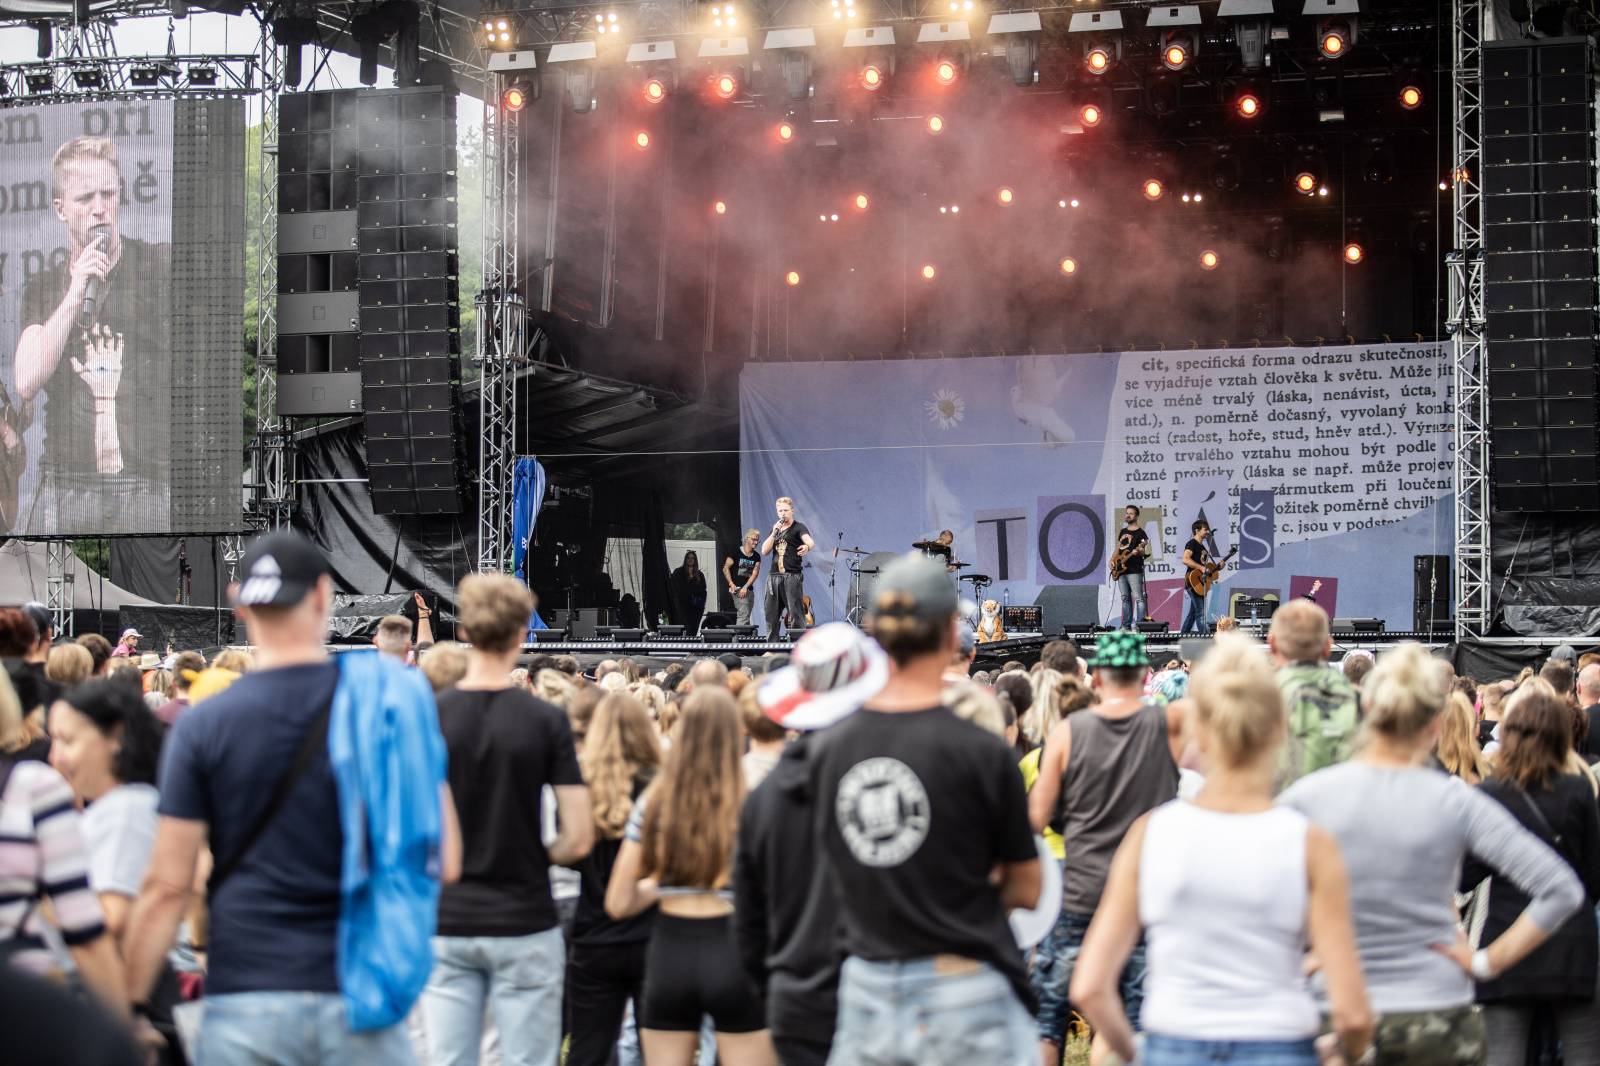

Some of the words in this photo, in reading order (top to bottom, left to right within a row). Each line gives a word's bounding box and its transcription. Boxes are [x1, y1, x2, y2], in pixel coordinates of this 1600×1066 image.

[1142, 357, 1169, 372] cit,
[1175, 355, 1246, 373] specifická
[1252, 353, 1295, 367] forma
[1302, 352, 1352, 365] odrazu
[1359, 345, 1447, 362] skutečnosti,
[1125, 380, 1139, 390] se
[1145, 376, 1212, 392] vyjadřuje
[1218, 373, 1257, 387] vztah
[1263, 371, 1318, 385] člověka
[1324, 370, 1333, 383] k
[1339, 368, 1382, 382] světu.
[1389, 364, 1432, 379] Může
[1125, 396, 1153, 409] více
[1163, 394, 1203, 407] méně
[1213, 391, 1255, 406] trvalý
[1266, 389, 1313, 406] (láska,
[1323, 386, 1390, 401] nenávist,
[1401, 385, 1436, 398] úcta,
[1125, 413, 1163, 428] atd.),
[1171, 415, 1185, 426] n.
[1195, 410, 1258, 427] poměrně
[1267, 407, 1331, 422] dočasný,
[1340, 403, 1407, 421] vyvolaný
[1126, 431, 1160, 445] tuací
[1168, 430, 1223, 446] (radost,
[1229, 428, 1266, 443] hoře,
[1272, 427, 1309, 441] stud,
[1315, 425, 1352, 438] hněv
[1358, 423, 1397, 438] atd.).
[1126, 450, 1164, 464] kožto
[1175, 448, 1234, 462] trvalého
[1242, 446, 1291, 460] vztahu
[1298, 444, 1350, 458] mohou
[1361, 442, 1386, 457] být
[1396, 439, 1437, 456] podle
[1126, 468, 1167, 482] různé
[1243, 465, 1285, 480] (láska
[1292, 465, 1307, 476] se
[1315, 462, 1353, 478] např.
[1361, 460, 1402, 474] může
[1126, 487, 1161, 500] dostí
[1365, 479, 1387, 495] při
[1398, 476, 1452, 491] loučení
[1323, 498, 1389, 515] poměrně
[1298, 519, 1328, 535] jsou
[1332, 521, 1341, 531] v
